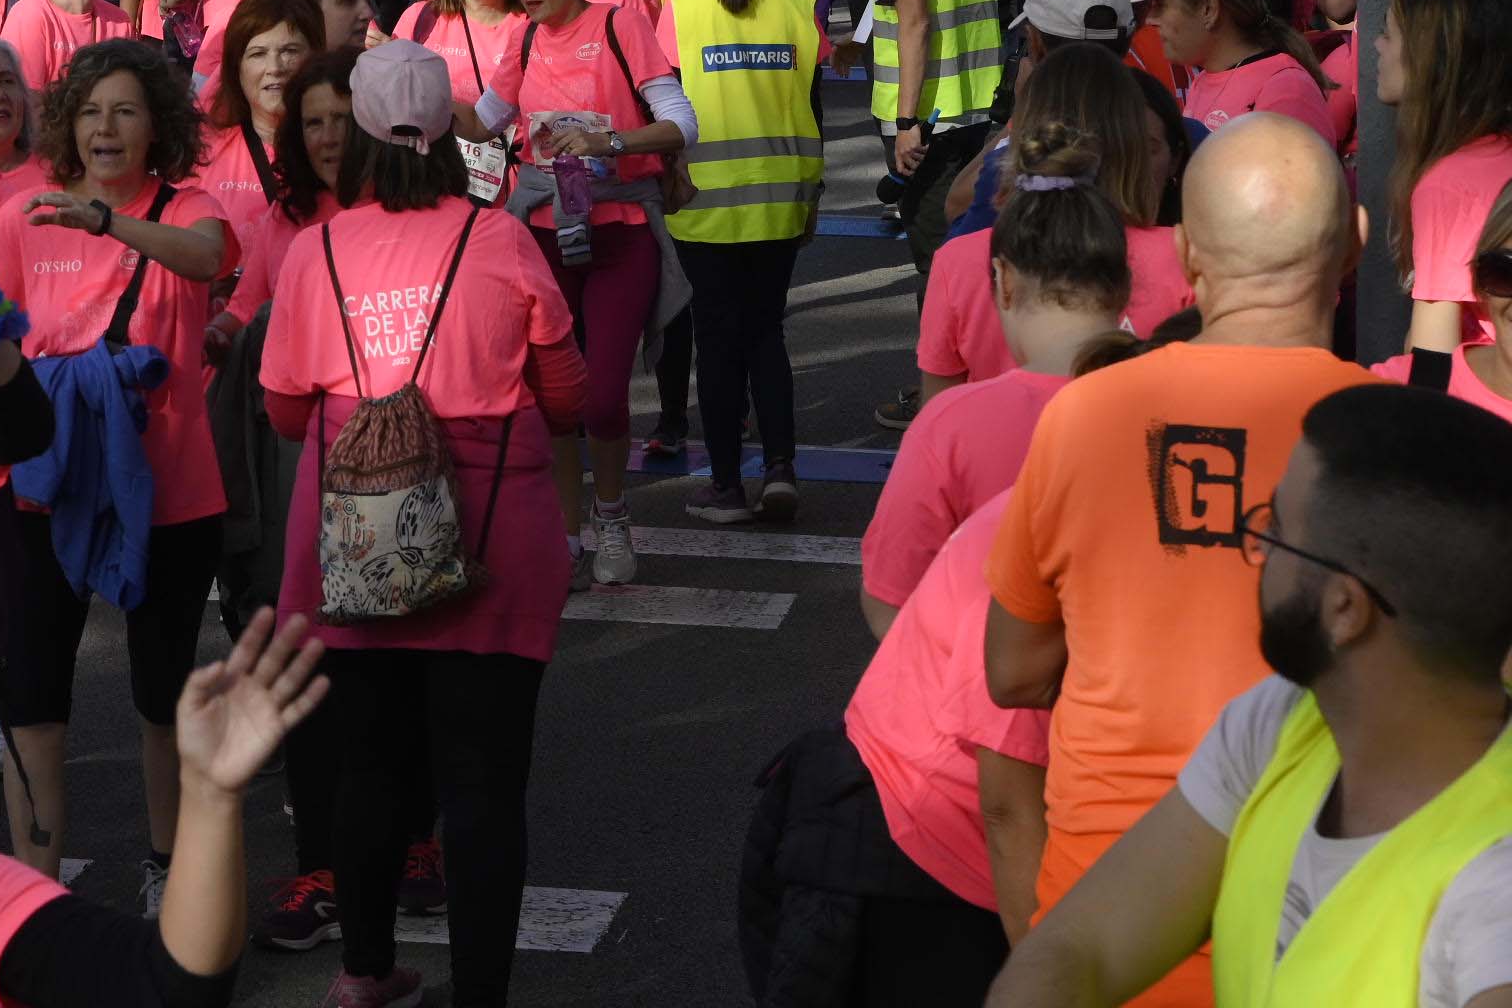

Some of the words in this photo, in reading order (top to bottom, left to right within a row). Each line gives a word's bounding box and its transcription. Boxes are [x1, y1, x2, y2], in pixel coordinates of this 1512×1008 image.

[705, 50, 790, 66] VOLUNTARIS
[34, 259, 82, 273] OYSHO
[343, 282, 449, 317] CARRERA
[365, 313, 395, 337] DE
[403, 308, 430, 331] LA
[1159, 424, 1246, 547] G
